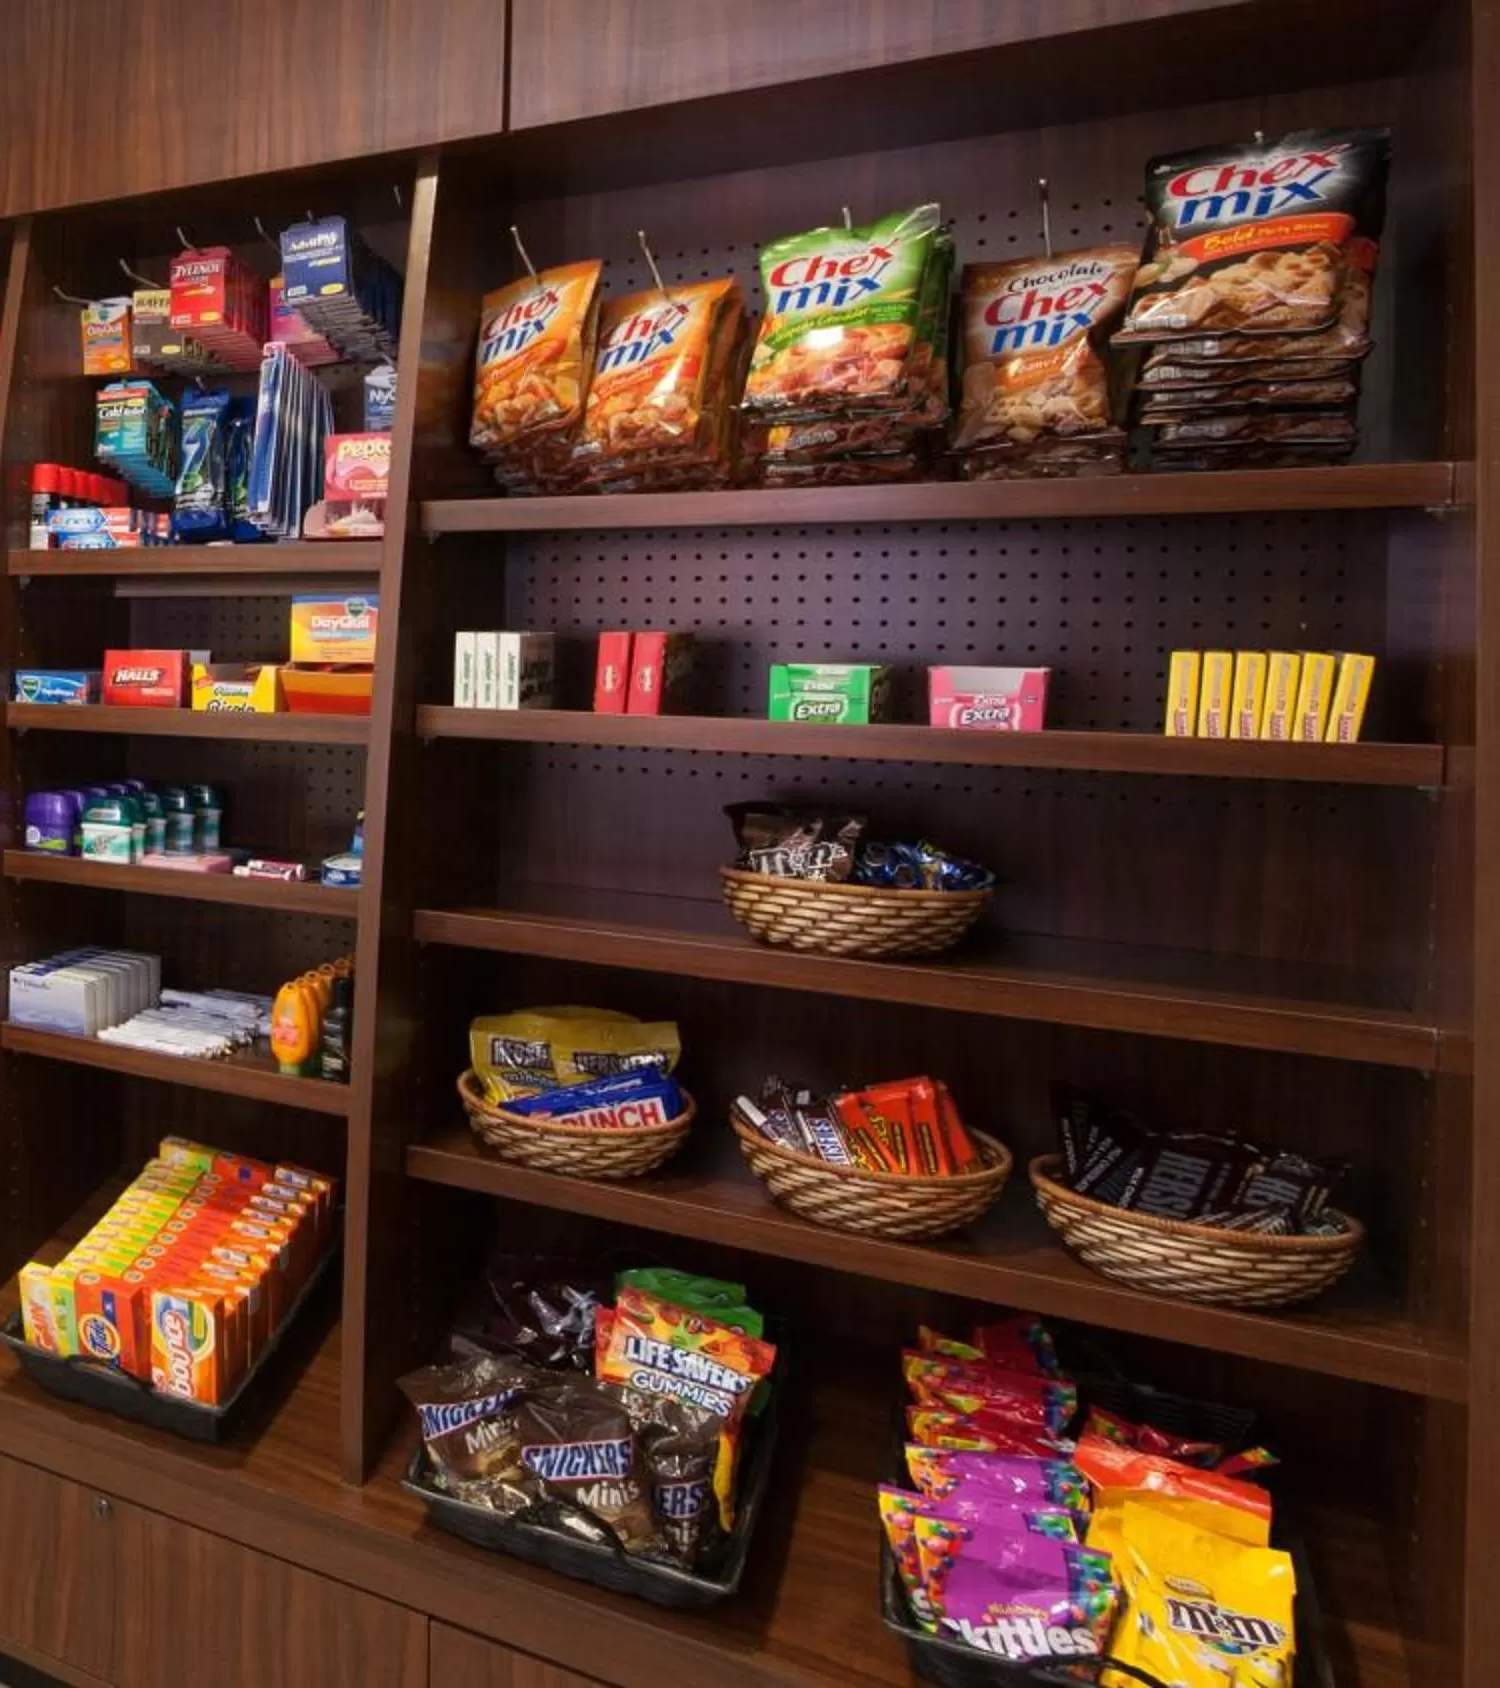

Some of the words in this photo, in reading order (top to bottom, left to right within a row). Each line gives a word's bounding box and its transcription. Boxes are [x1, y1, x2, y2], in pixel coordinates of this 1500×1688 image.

[1170, 144, 1351, 197] Chex
[1179, 170, 1332, 226] mix
[770, 238, 899, 287] Chex
[776, 260, 891, 313] mix
[1008, 261, 1107, 292] Chocolate
[482, 289, 558, 341] Chex
[984, 273, 1115, 326] Chex
[482, 306, 557, 364] mix
[599, 317, 684, 373] mix
[601, 303, 690, 349] Chex
[992, 298, 1105, 354] mix
[115, 669, 160, 683] HALLS
[795, 702, 842, 719] Extra
[961, 709, 1010, 725] Extra
[632, 1369, 734, 1418] GUMMIES
[523, 1440, 630, 1478] SNICKERS
[576, 1480, 641, 1510] Minis
